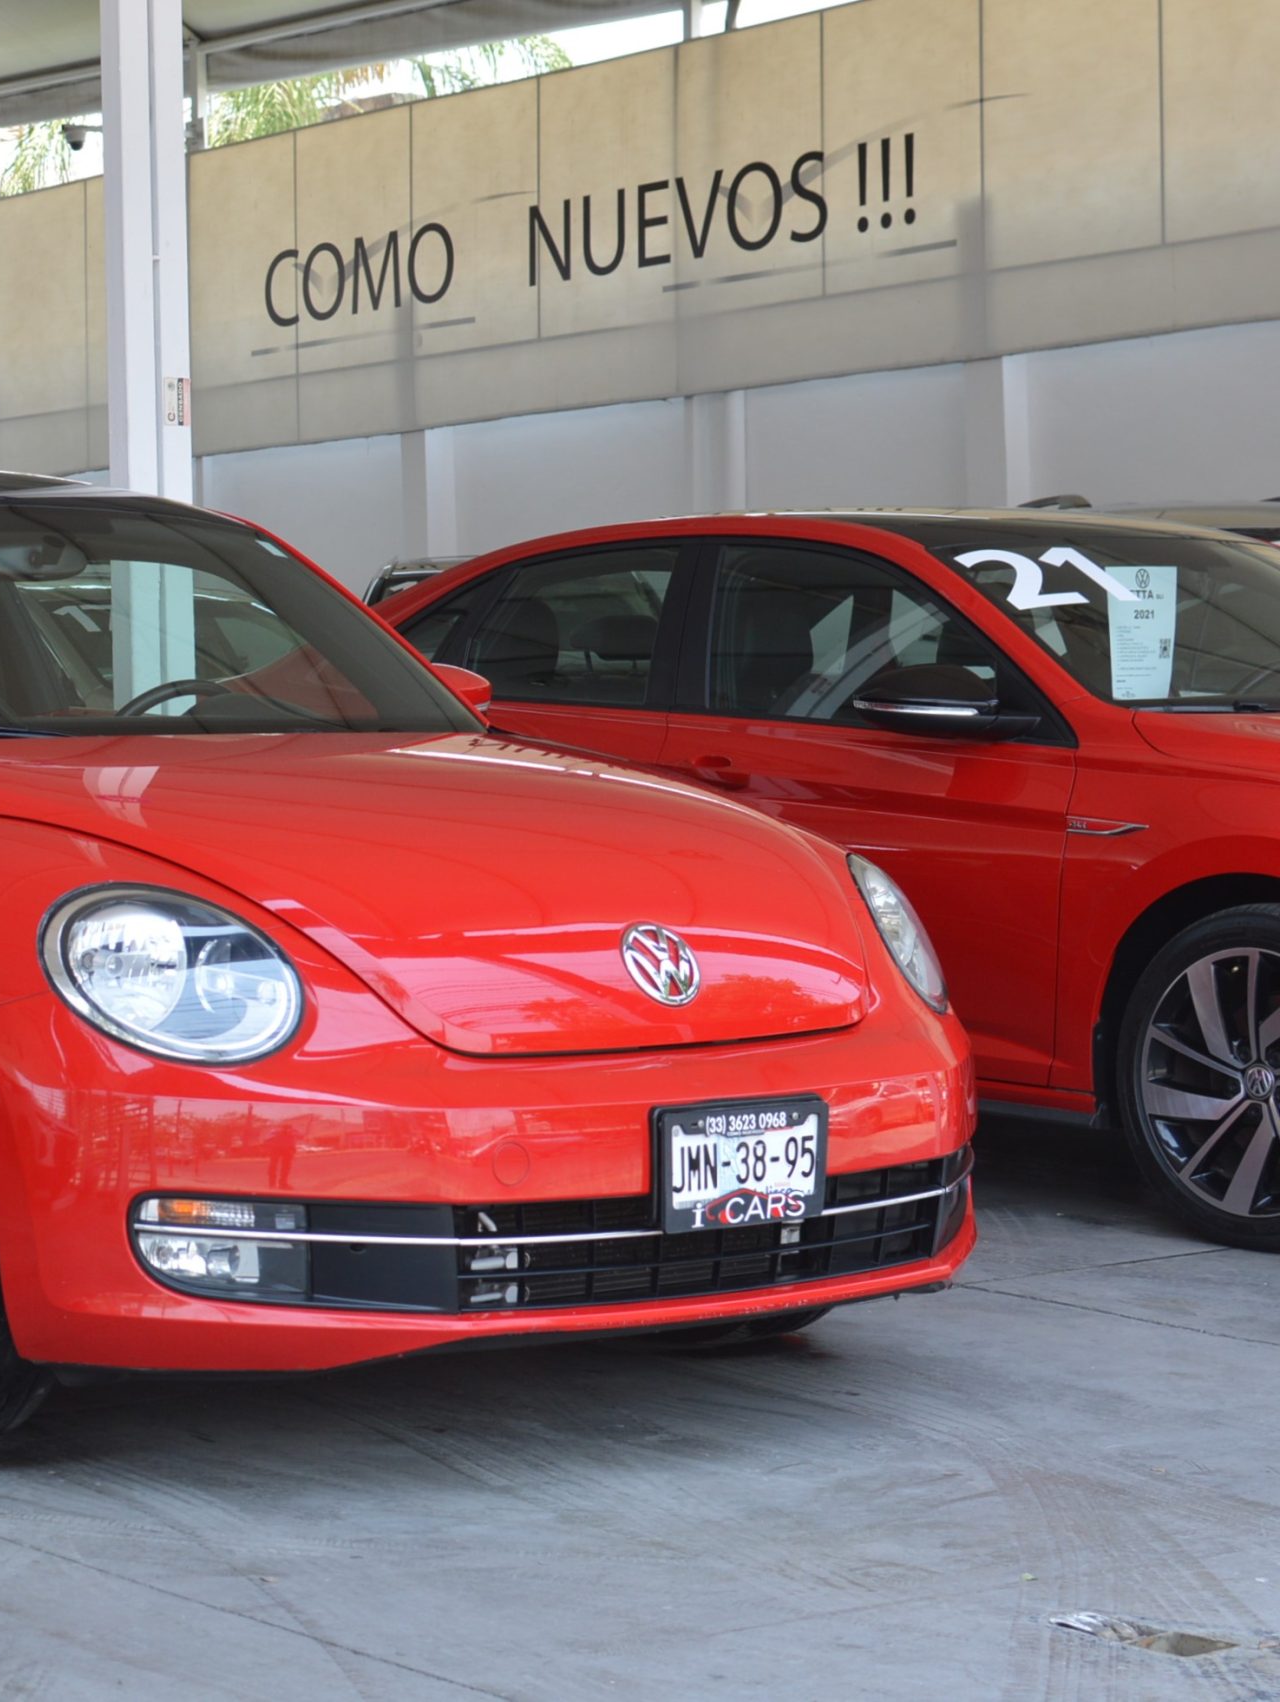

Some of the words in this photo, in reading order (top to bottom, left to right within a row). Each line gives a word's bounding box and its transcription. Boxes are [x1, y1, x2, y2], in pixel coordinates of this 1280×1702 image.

[264, 221, 456, 328] COMO
[528, 150, 829, 288] NUEVOS
[953, 546, 1143, 611] 21
[1134, 609, 1155, 620] 2021
[706, 1114, 726, 1136] (33)
[729, 1113, 756, 1132] 3623
[759, 1111, 787, 1128] 0968
[672, 1135, 816, 1195] JMN-38-95
[725, 1191, 806, 1225] CARS
